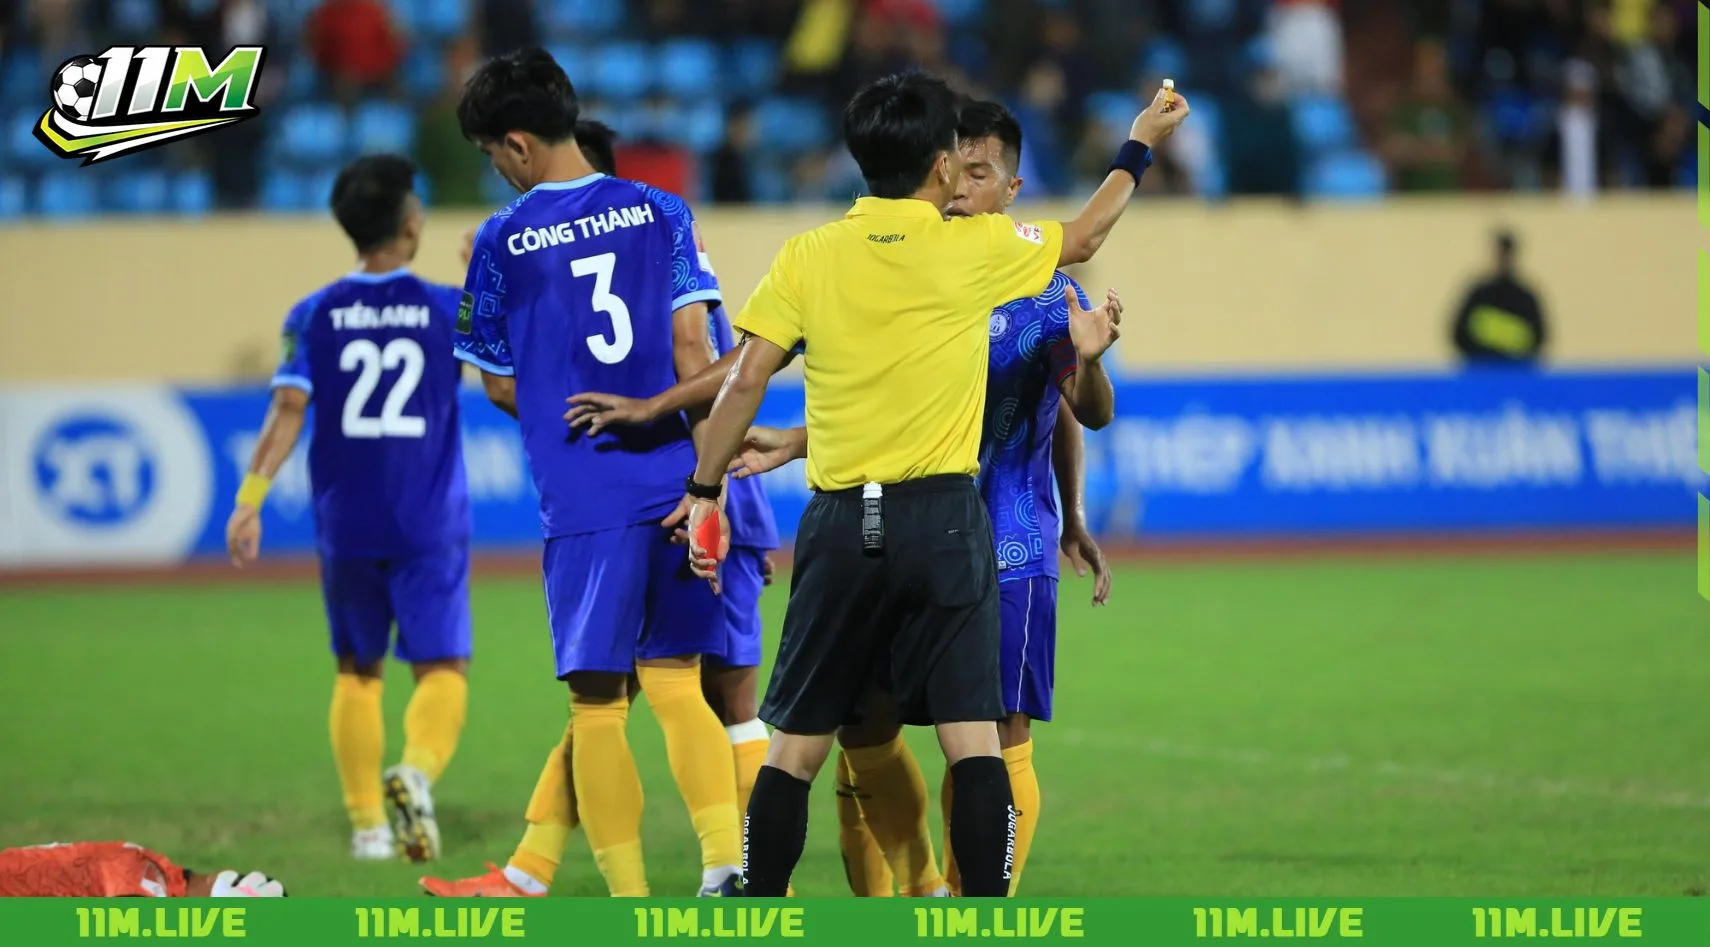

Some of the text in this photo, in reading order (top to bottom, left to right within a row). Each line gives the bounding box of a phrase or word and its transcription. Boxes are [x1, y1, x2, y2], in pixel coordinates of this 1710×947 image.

[507, 203, 655, 256] CÔNG THÀNH
[380, 304, 431, 329] ANH
[570, 252, 634, 365] 3
[339, 337, 427, 438] 22
[1002, 804, 1016, 880] JOGARBOLA
